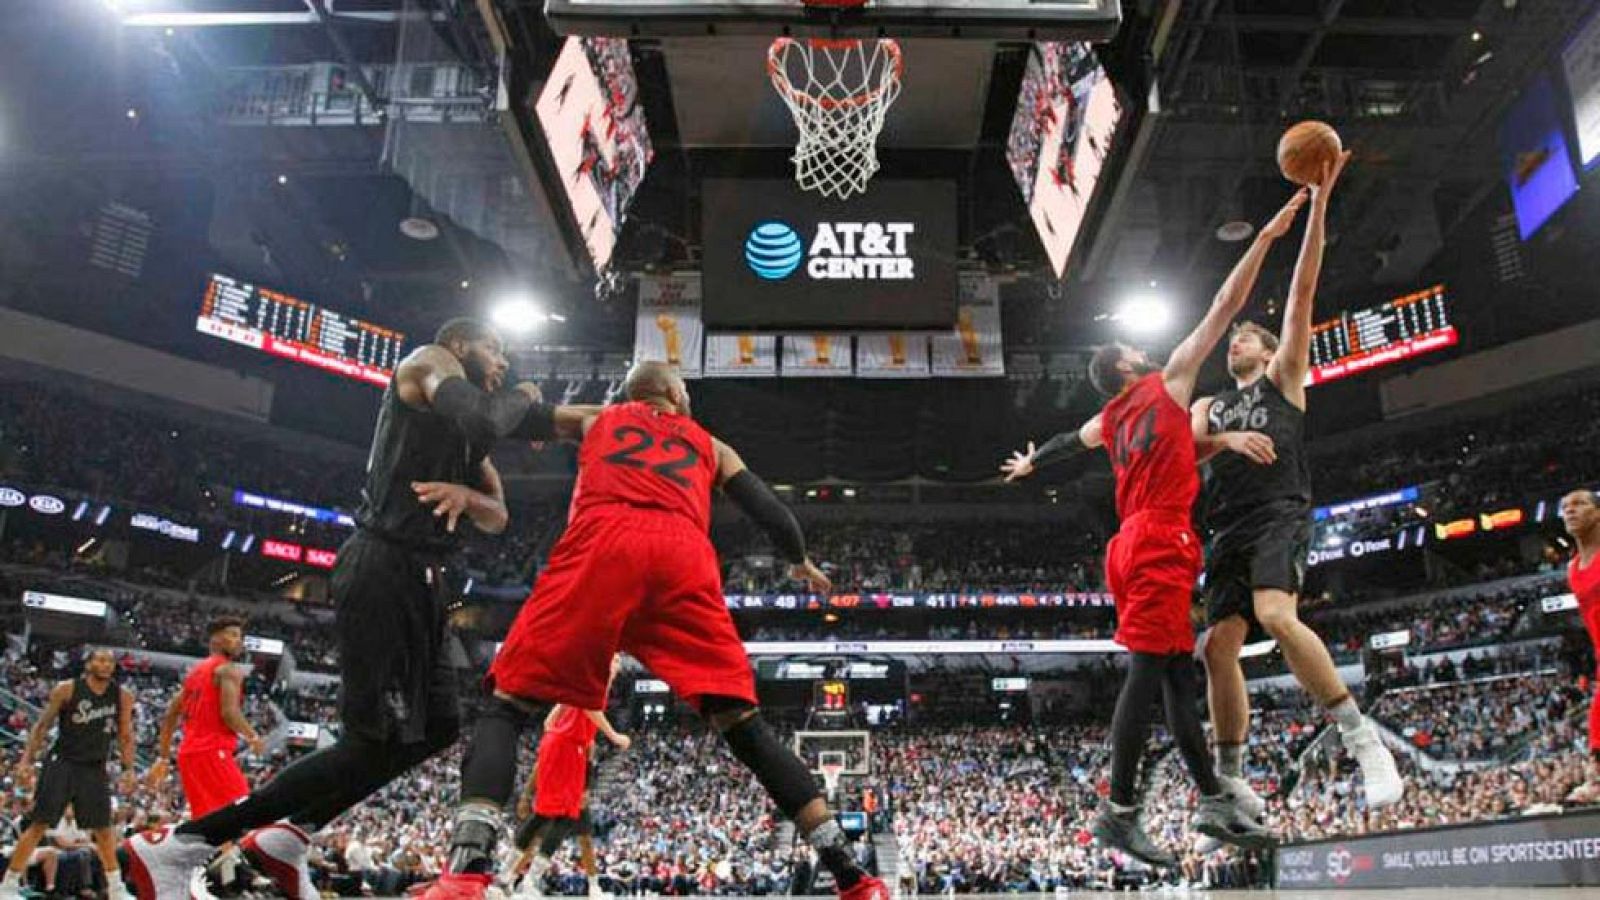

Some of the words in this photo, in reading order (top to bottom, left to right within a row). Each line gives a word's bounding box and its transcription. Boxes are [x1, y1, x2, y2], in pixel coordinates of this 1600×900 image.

[809, 222, 914, 256] AT&T
[807, 257, 914, 279] CENTER
[604, 425, 700, 489] 22
[1326, 850, 1352, 877] SC
[1453, 848, 1469, 865] BE
[1470, 846, 1489, 864] ON
